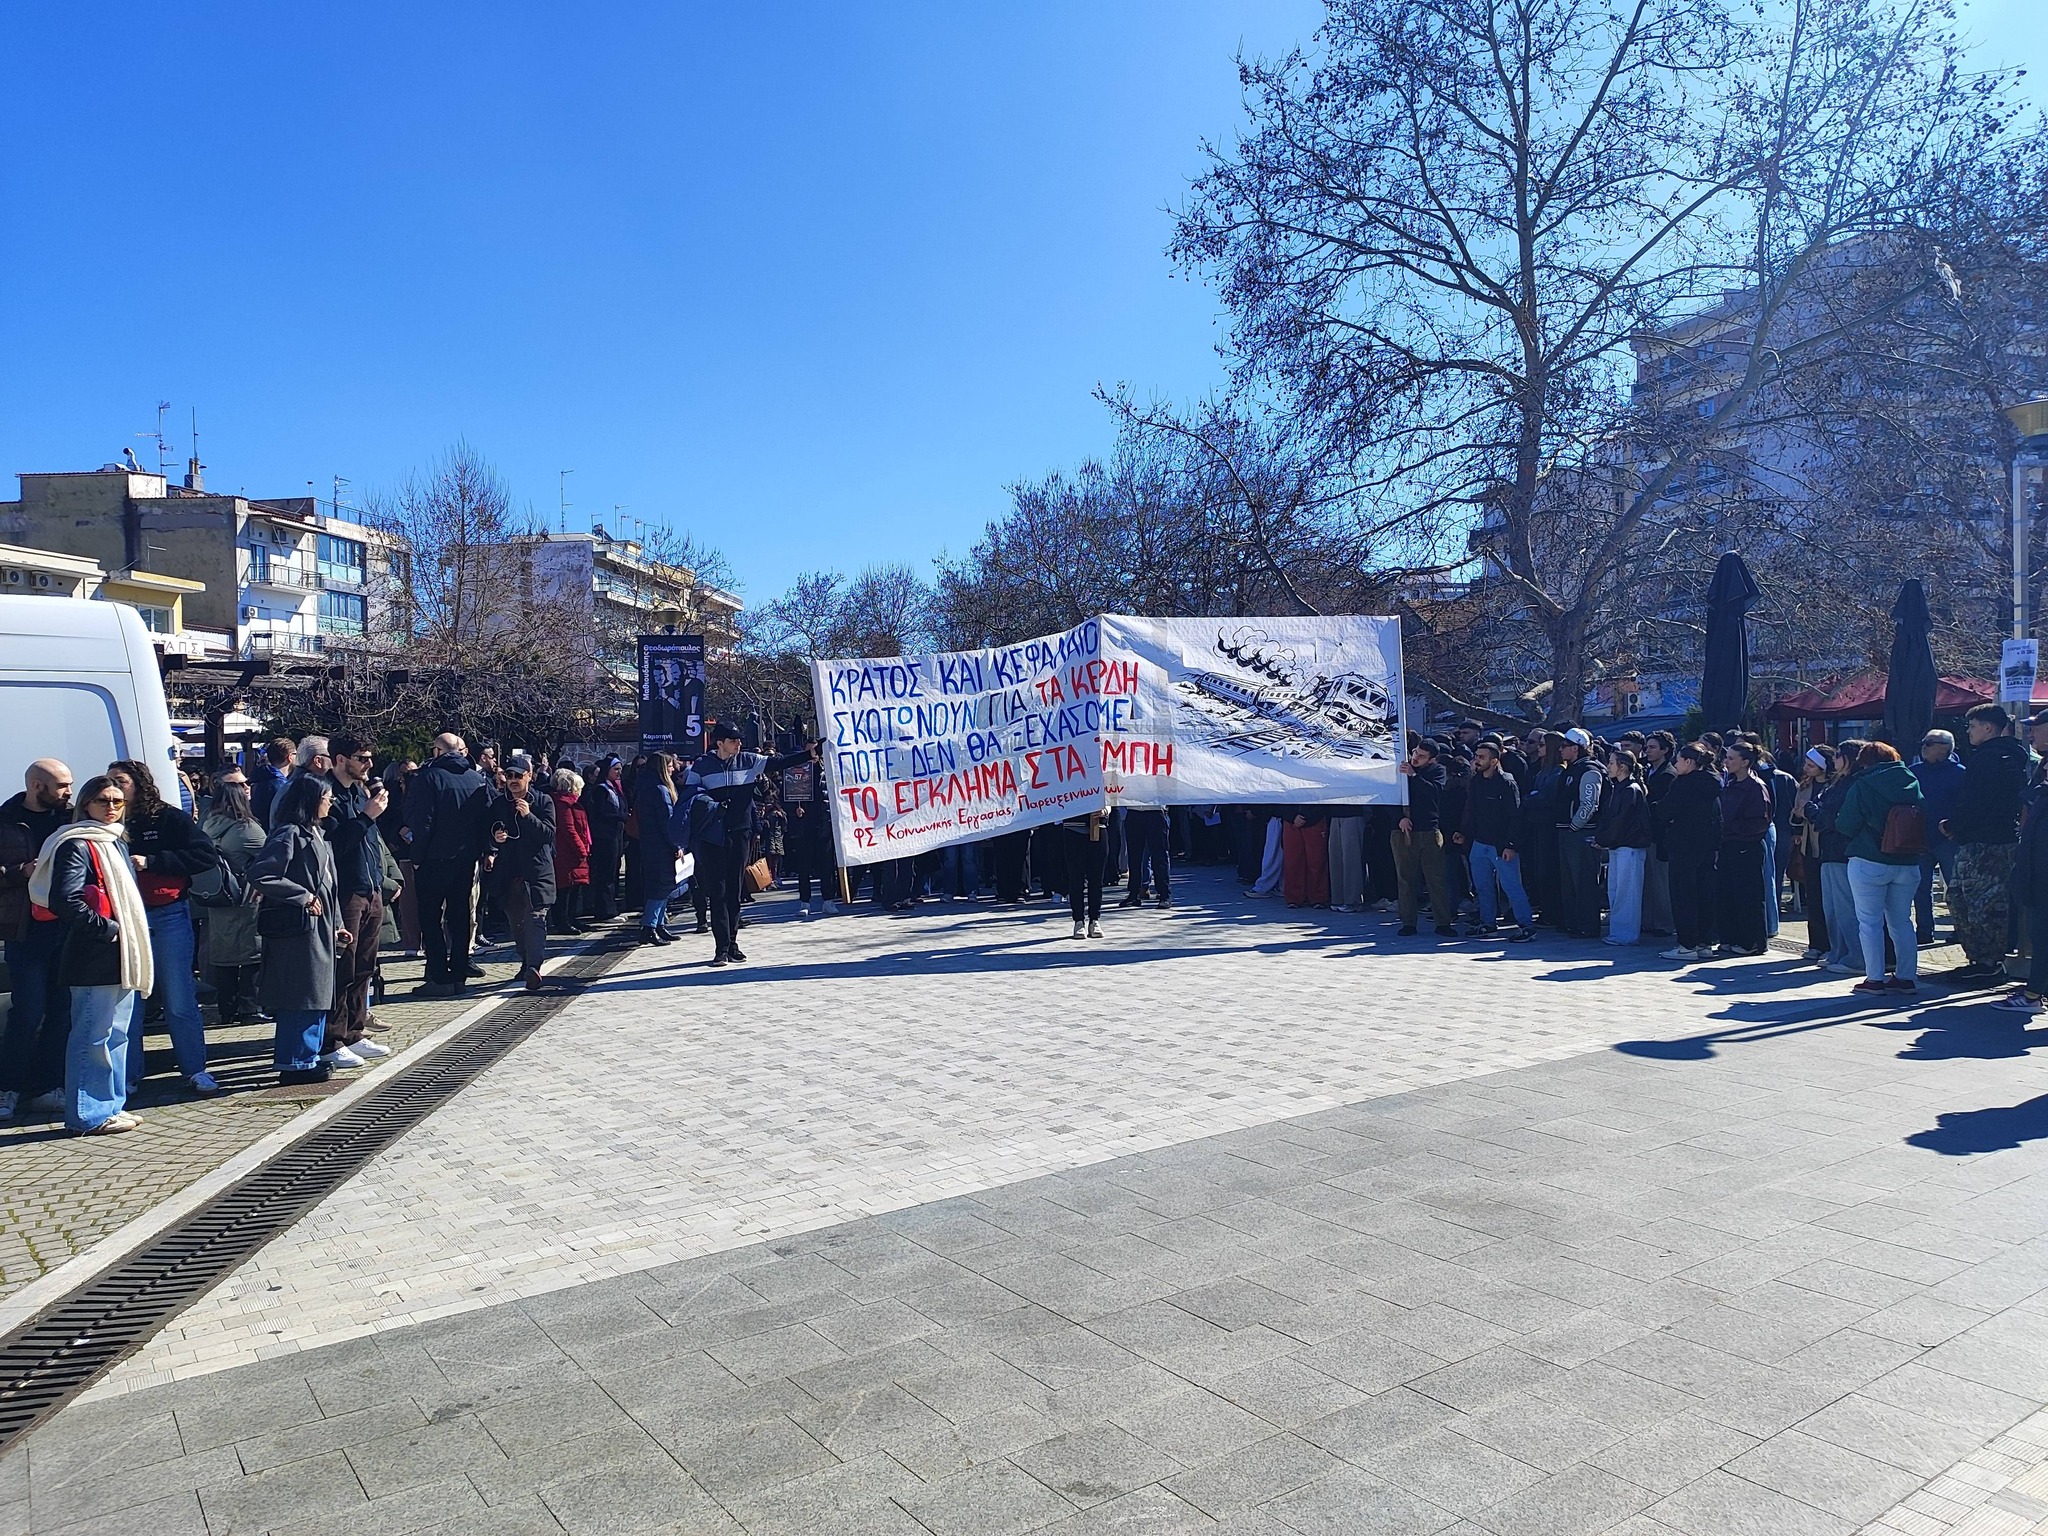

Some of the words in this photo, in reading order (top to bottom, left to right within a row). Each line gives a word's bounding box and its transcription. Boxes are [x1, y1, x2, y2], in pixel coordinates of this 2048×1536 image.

[828, 663, 924, 706] ΚΡΑΤΟΣ
[938, 657, 983, 695] ΚΑΙ
[993, 621, 1099, 689] ΚΕΦΑΛΑΙΟ
[686, 714, 702, 737] 5
[833, 699, 978, 747] ΣΚΟΤΩΝΟΥΝ
[988, 689, 1028, 727] ΓΙΑ
[1035, 675, 1066, 707] ΤΑ
[838, 746, 901, 786] ΠΟΤΕ
[911, 739, 956, 777] ΔΕΝ
[966, 731, 1002, 762] ΘΑ
[1008, 698, 1130, 752] ΞΕΧΑΣΟΜΕ
[841, 786, 880, 823] ΤΟ
[894, 760, 1018, 815] ΕΓΚΛΗΜΑ
[1025, 744, 1086, 789] ΣΤΑ
[1094, 737, 1174, 777] ΜΠΗ
[886, 817, 952, 842] Κοινωνικής
